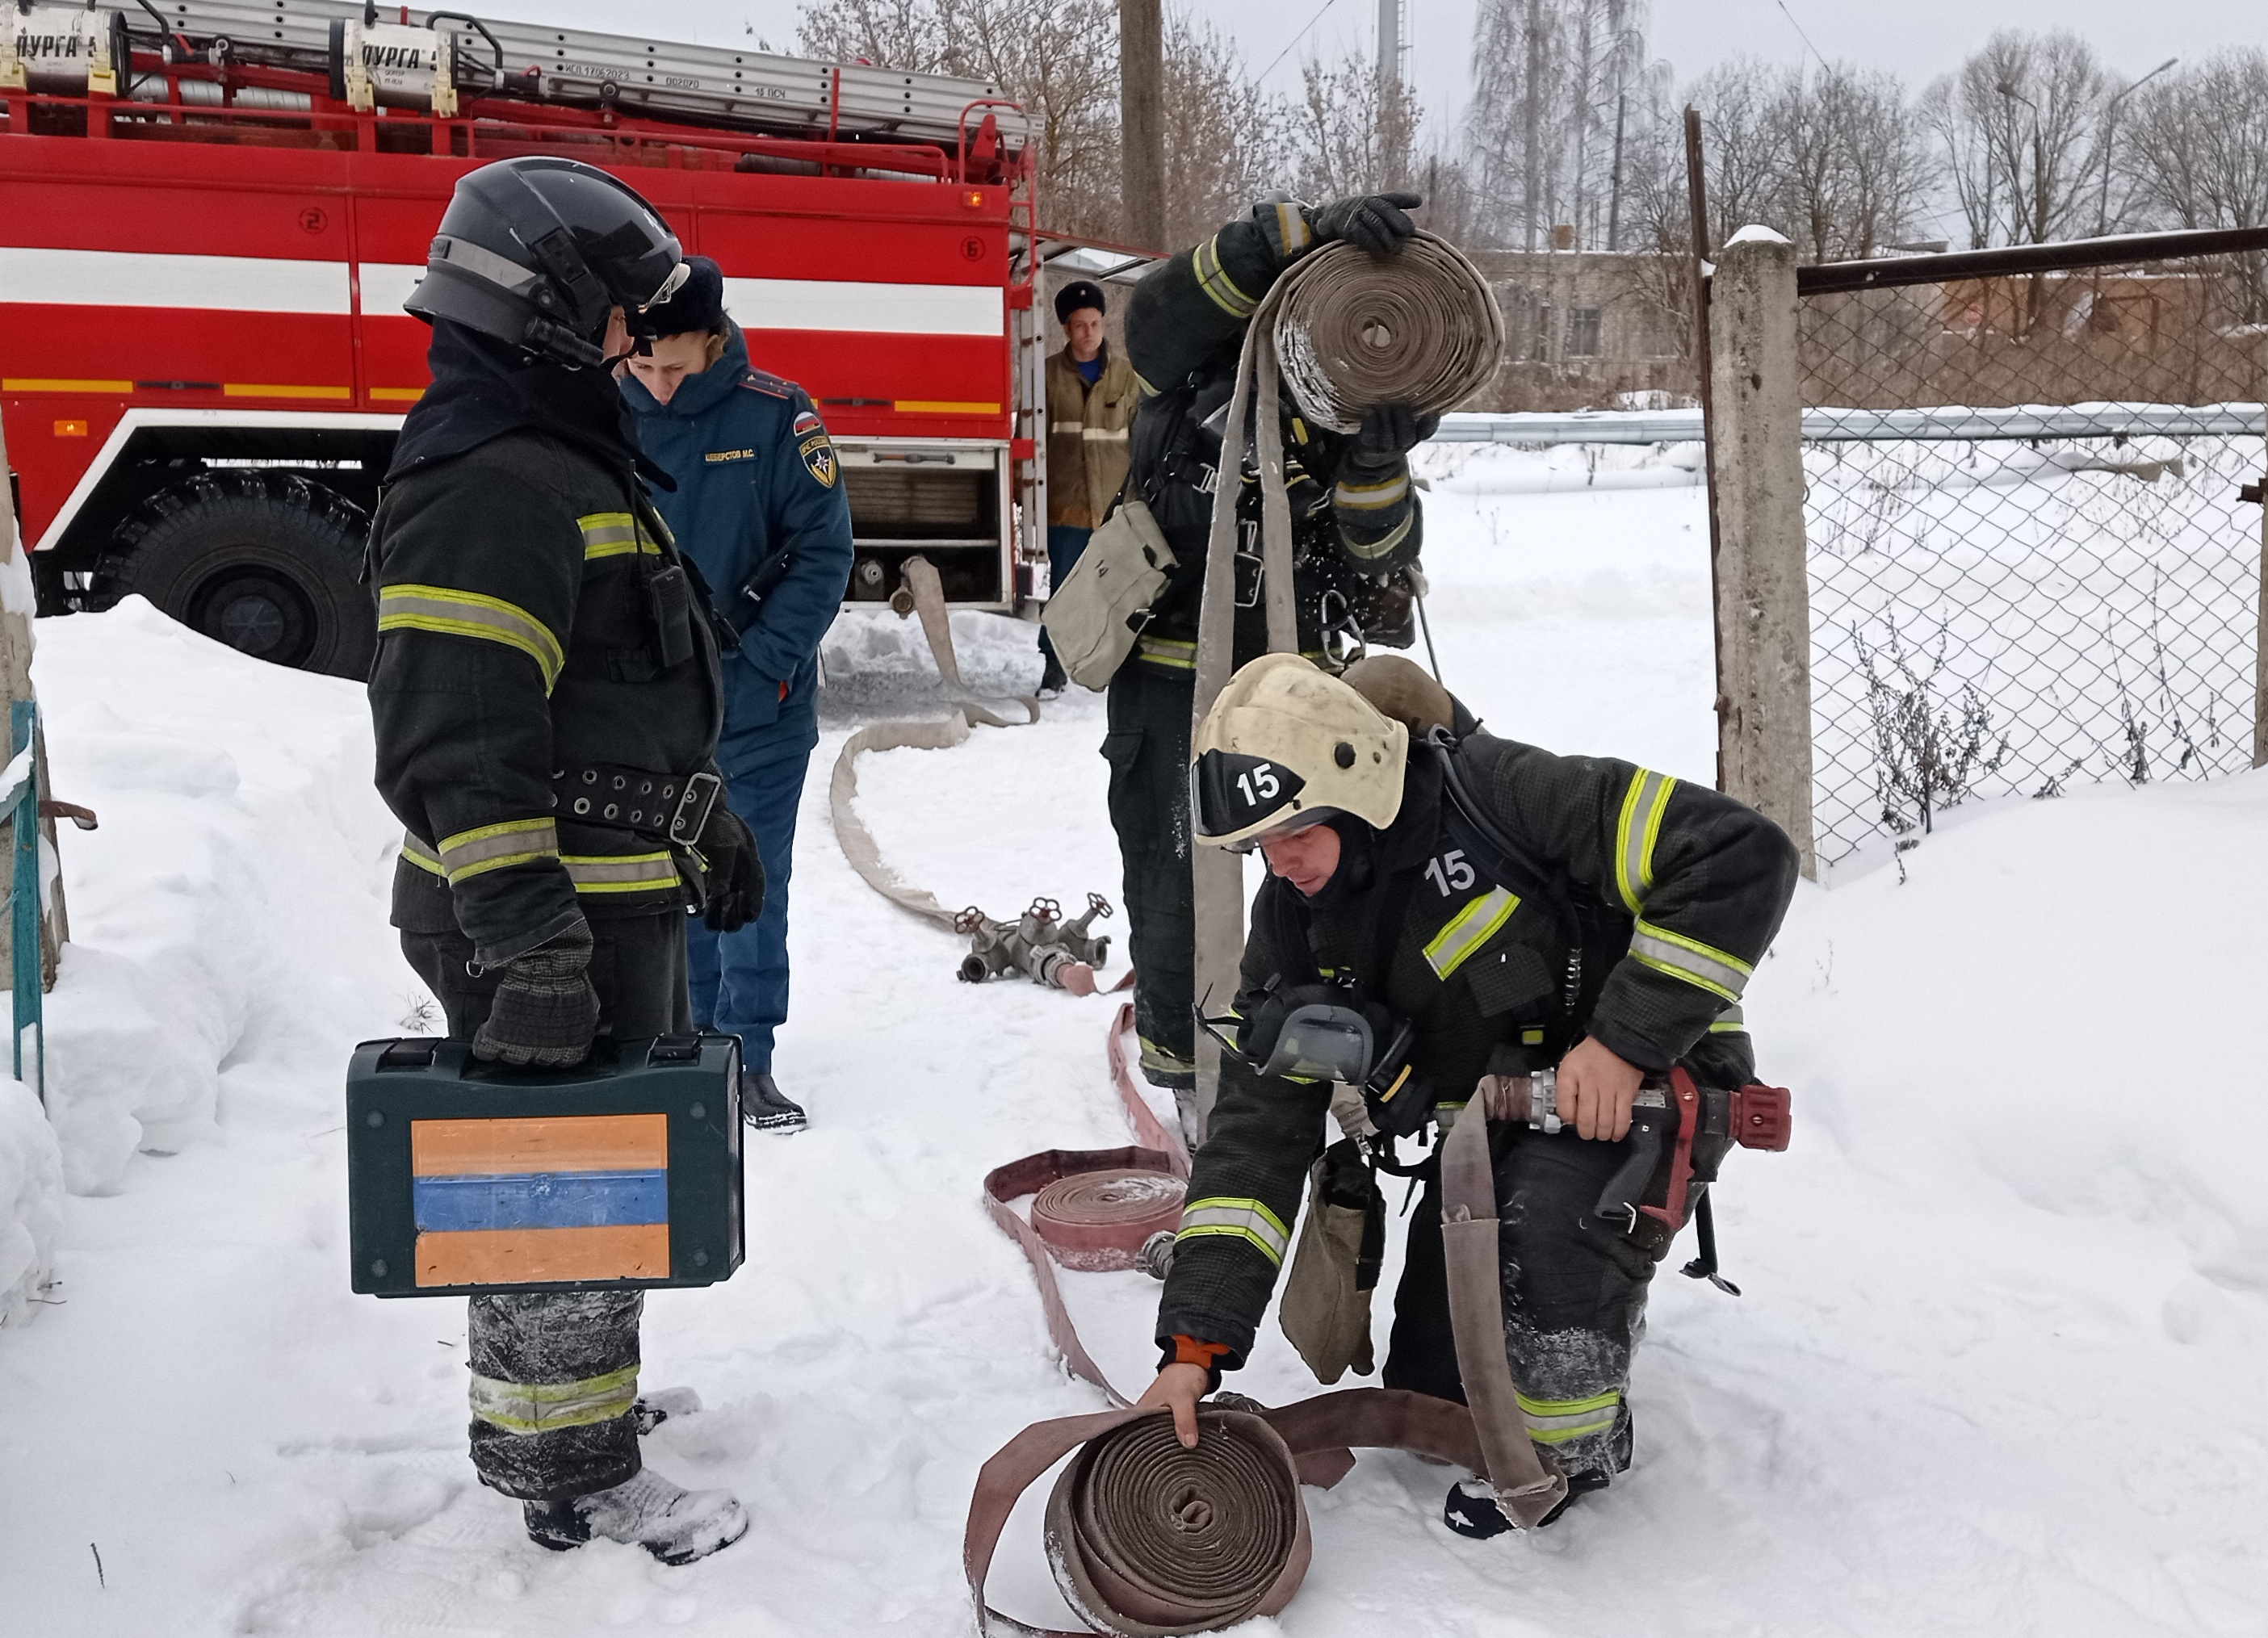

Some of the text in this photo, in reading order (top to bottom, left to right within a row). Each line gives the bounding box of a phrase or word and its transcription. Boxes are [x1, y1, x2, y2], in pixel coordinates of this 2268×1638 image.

[16, 35, 78, 57] ПУРГА
[363, 45, 420, 69] ПУРГА
[307, 212, 321, 230] 2
[1236, 763, 1280, 806] 15
[1423, 848, 1475, 897] 15
